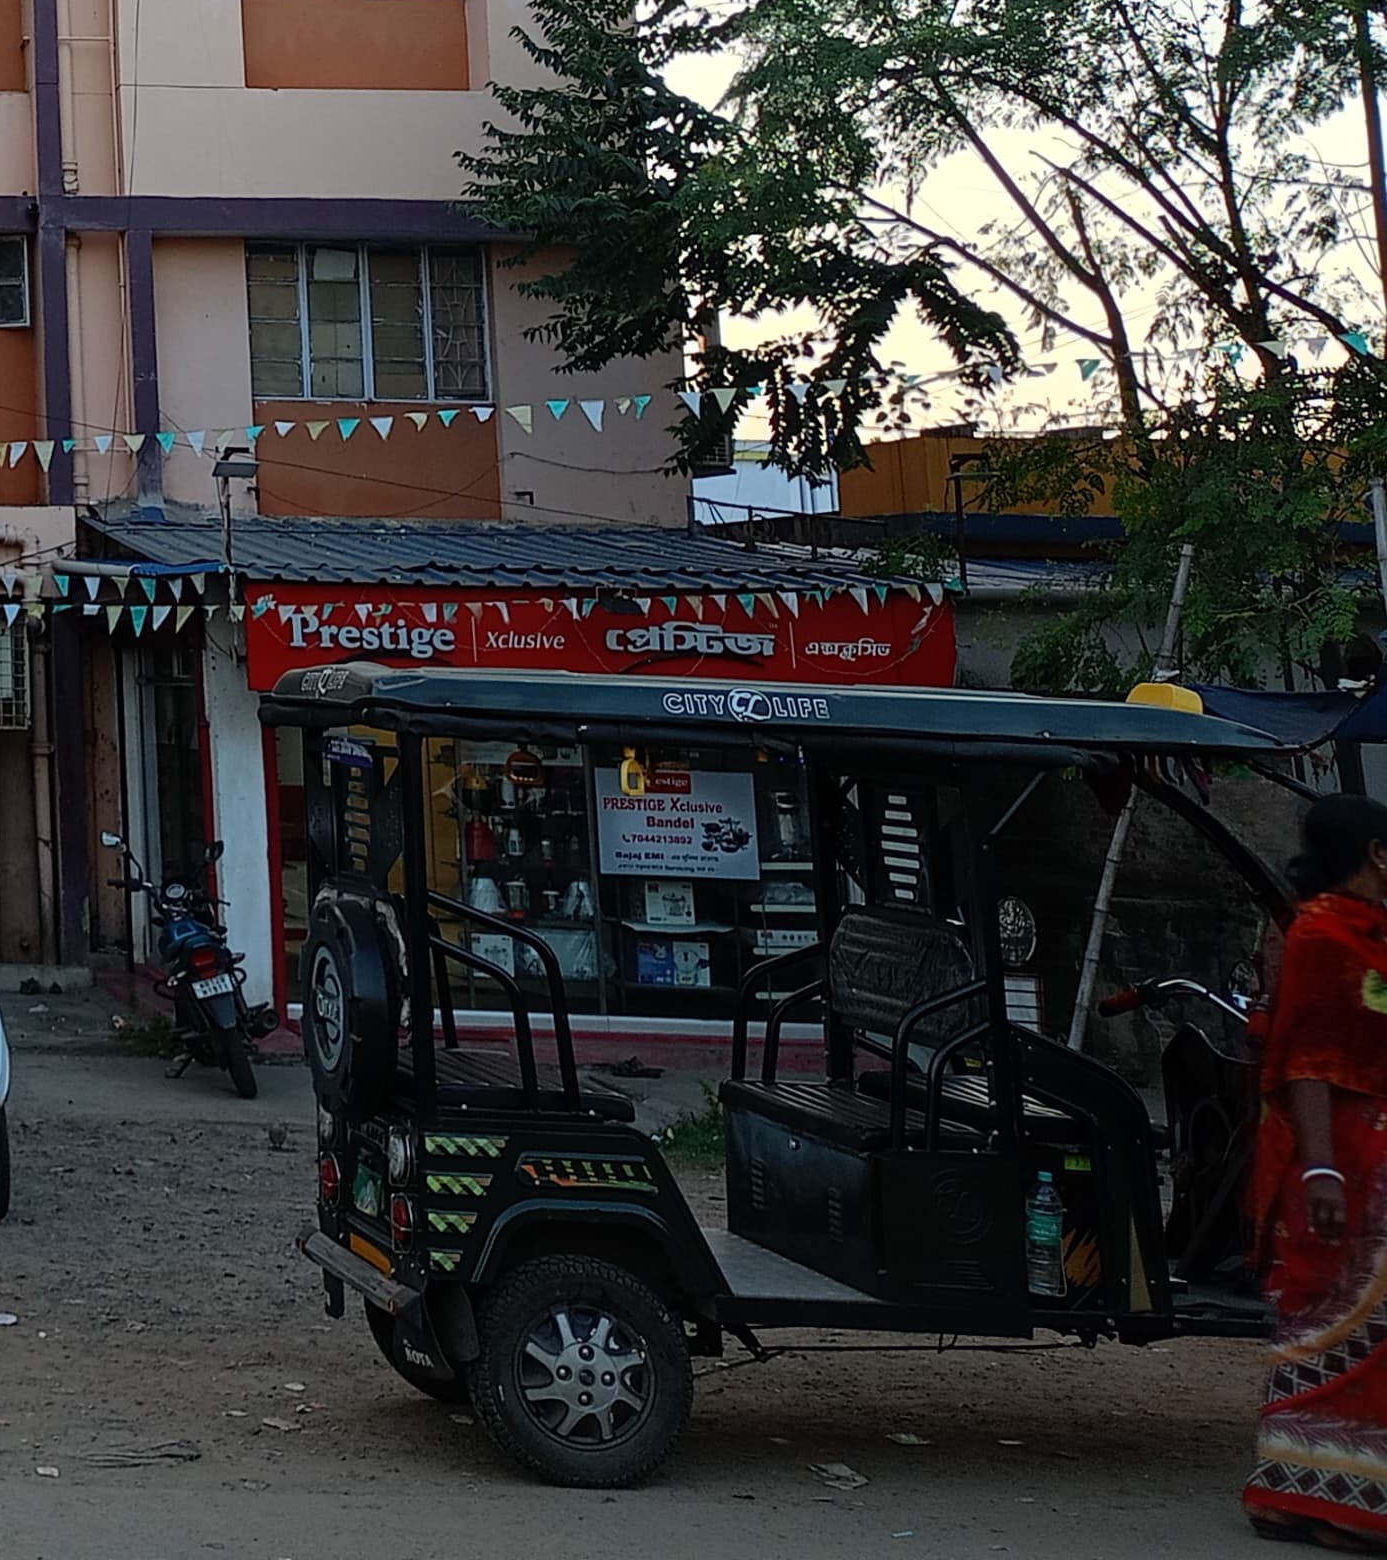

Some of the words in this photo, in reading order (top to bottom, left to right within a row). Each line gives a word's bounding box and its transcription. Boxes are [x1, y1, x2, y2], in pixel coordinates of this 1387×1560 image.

[289, 612, 456, 659] Prestige
[485, 631, 566, 650] Xclusive
[662, 693, 725, 715] CITY
[771, 697, 831, 719] LIFE
[603, 797, 665, 811] PRESTIGE
[670, 797, 723, 814] Xclusive
[646, 815, 695, 829] Bandel
